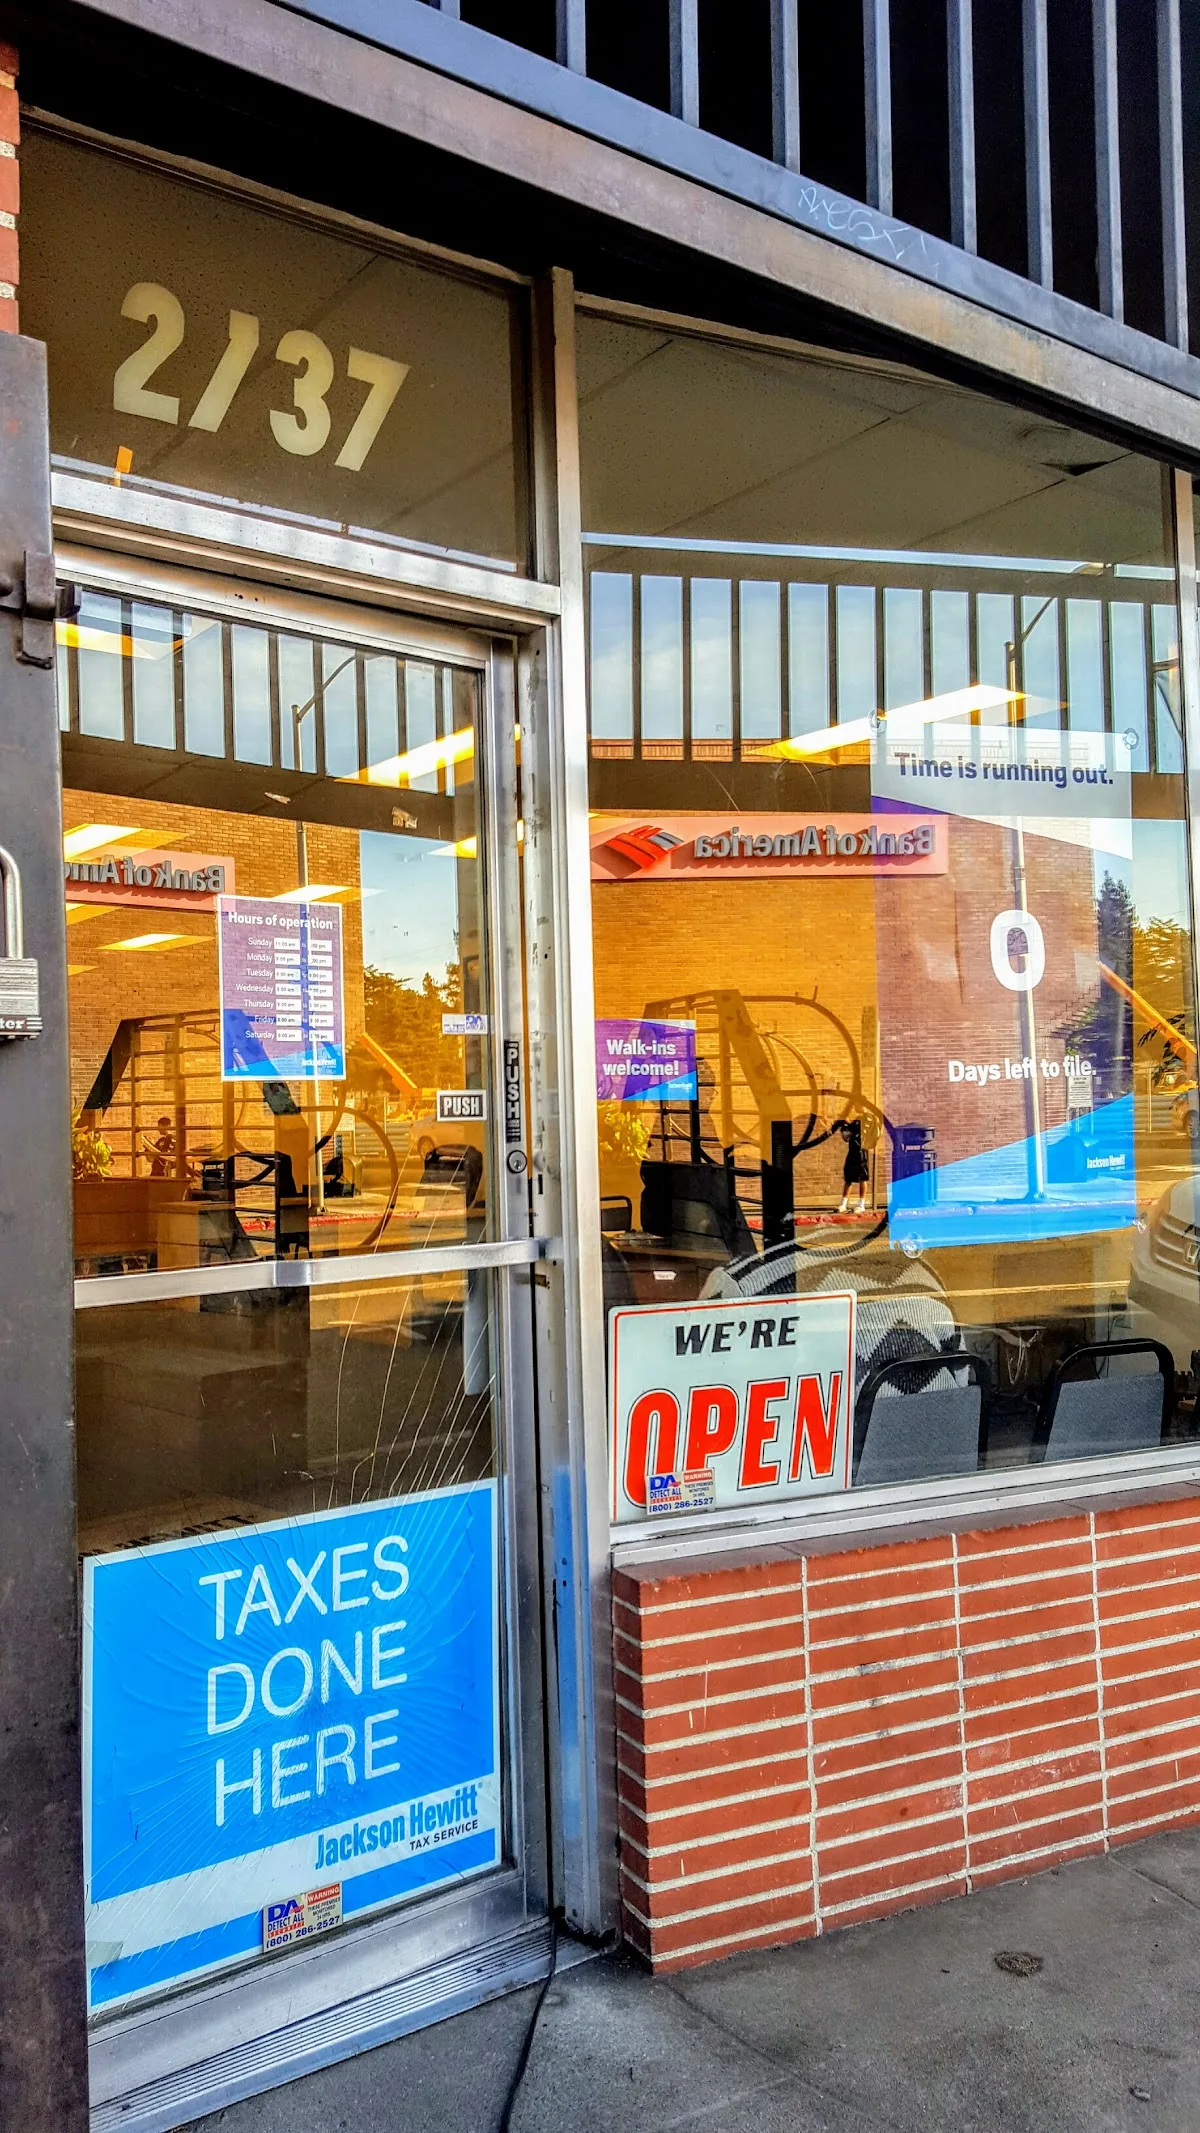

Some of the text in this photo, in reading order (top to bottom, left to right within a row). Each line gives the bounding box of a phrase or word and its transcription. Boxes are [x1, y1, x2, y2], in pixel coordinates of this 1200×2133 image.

[894, 752, 1114, 789] Time is running out.
[228, 911, 333, 930] Hours of operation
[248, 937, 272, 947] Sunday
[990, 909, 1046, 992] 0
[247, 953, 273, 963] Monday
[246, 968, 273, 978] Tuesday
[235, 984, 274, 993] Wednesday
[244, 999, 274, 1008] Thursday
[255, 1015, 275, 1024] Friday
[245, 1031, 275, 1039] Saturday
[606, 1039, 676, 1055] Walk-ins
[602, 1059, 679, 1076] welcome!
[948, 1055, 1097, 1086] Days left to file.
[505, 1047, 519, 1119] PUSH
[443, 1096, 480, 1116] PUSH
[675, 1316, 800, 1356] WE'RE
[623, 1370, 843, 1508] OPEN
[685, 1472, 712, 1481] WARNING
[650, 1489, 670, 1499] DETECT
[649, 1498, 713, 1512] (800) 286-2527
[199, 1535, 409, 1641] TAXES
[207, 1620, 408, 1735] DONE
[216, 1709, 401, 1826] HERE
[315, 1815, 405, 1870] Jackson
[410, 1819, 479, 1851] TAX SERVICE
[307, 1886, 340, 1904] WARNING
[266, 1915, 340, 1948] (800) 286-2527
[268, 1912, 304, 1932] DETECT ALL
